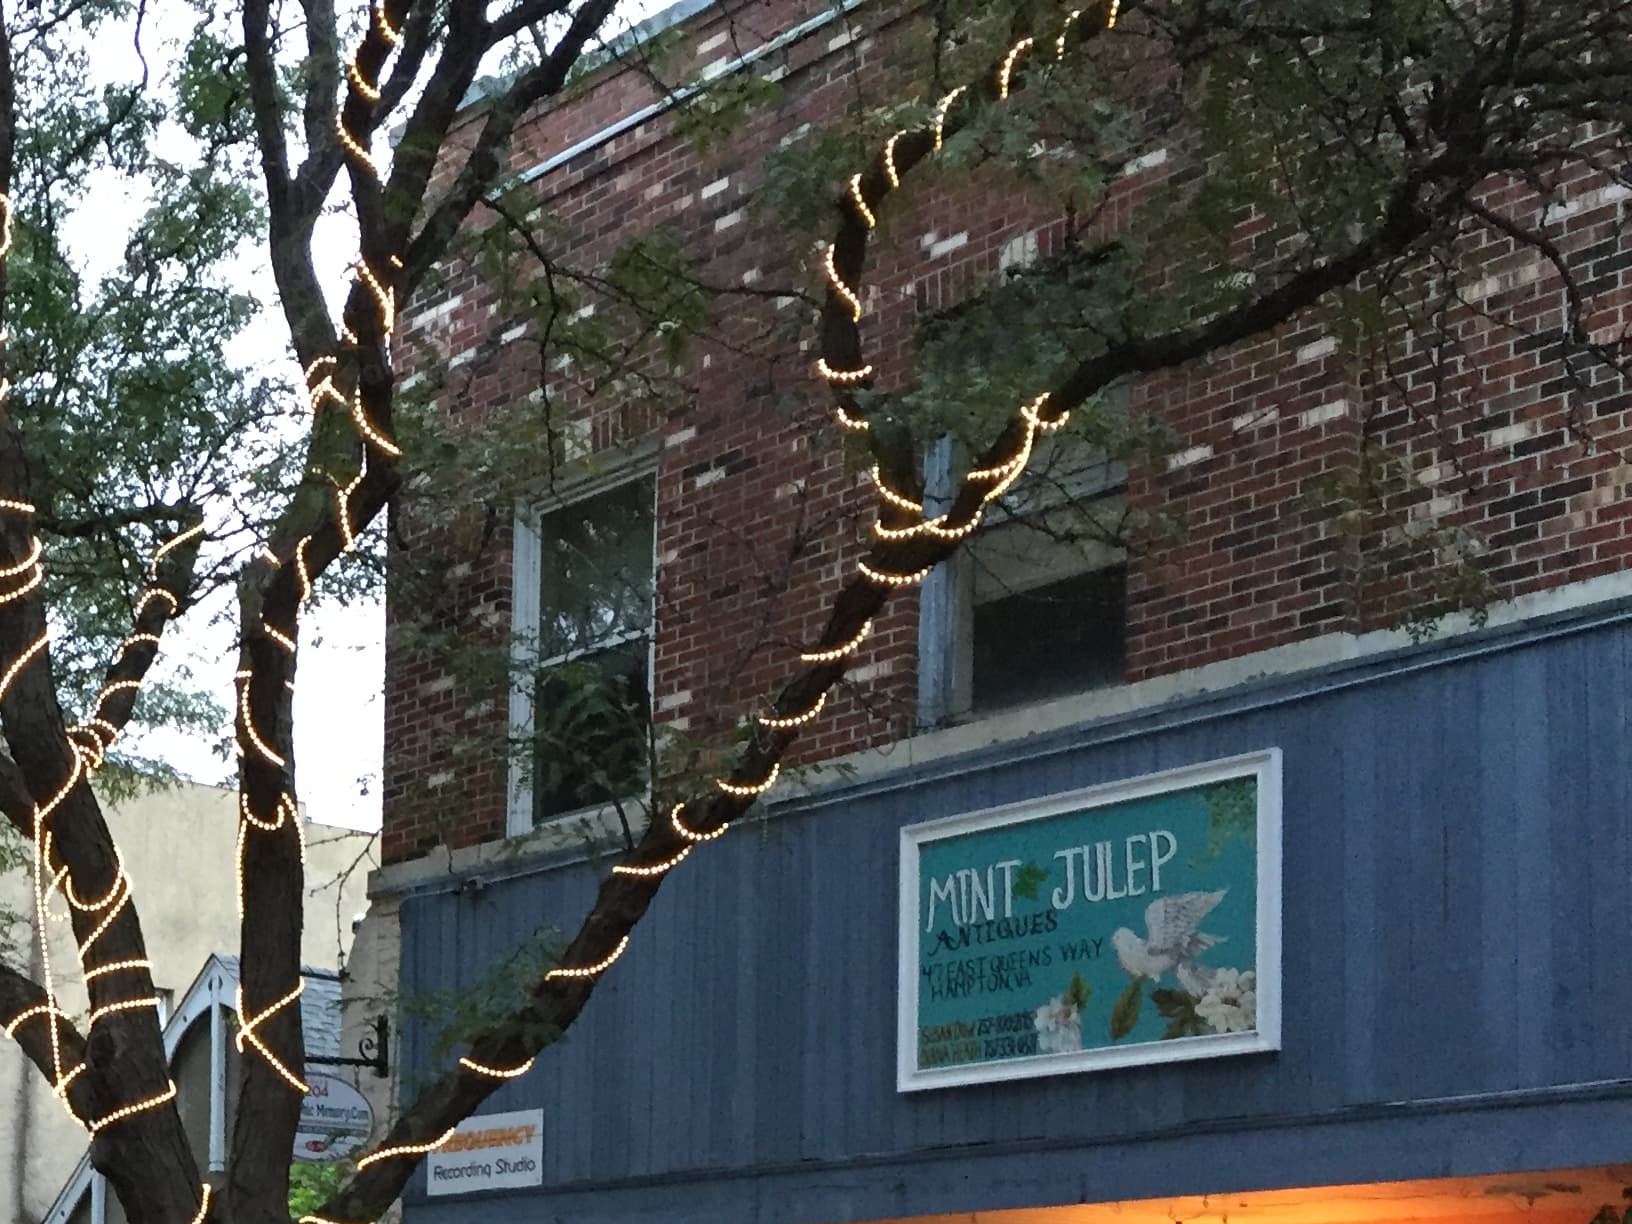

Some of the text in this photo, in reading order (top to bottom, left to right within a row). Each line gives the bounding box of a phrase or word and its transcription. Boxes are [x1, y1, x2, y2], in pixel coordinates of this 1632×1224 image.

[925, 831, 1178, 933] MINT JULEP
[928, 909, 1058, 956] ANTIQUES
[947, 956, 986, 978] EAST
[989, 946, 1053, 973] QUEENS
[1060, 937, 1104, 963] WAY
[433, 1156, 537, 1181] Recording Studio
